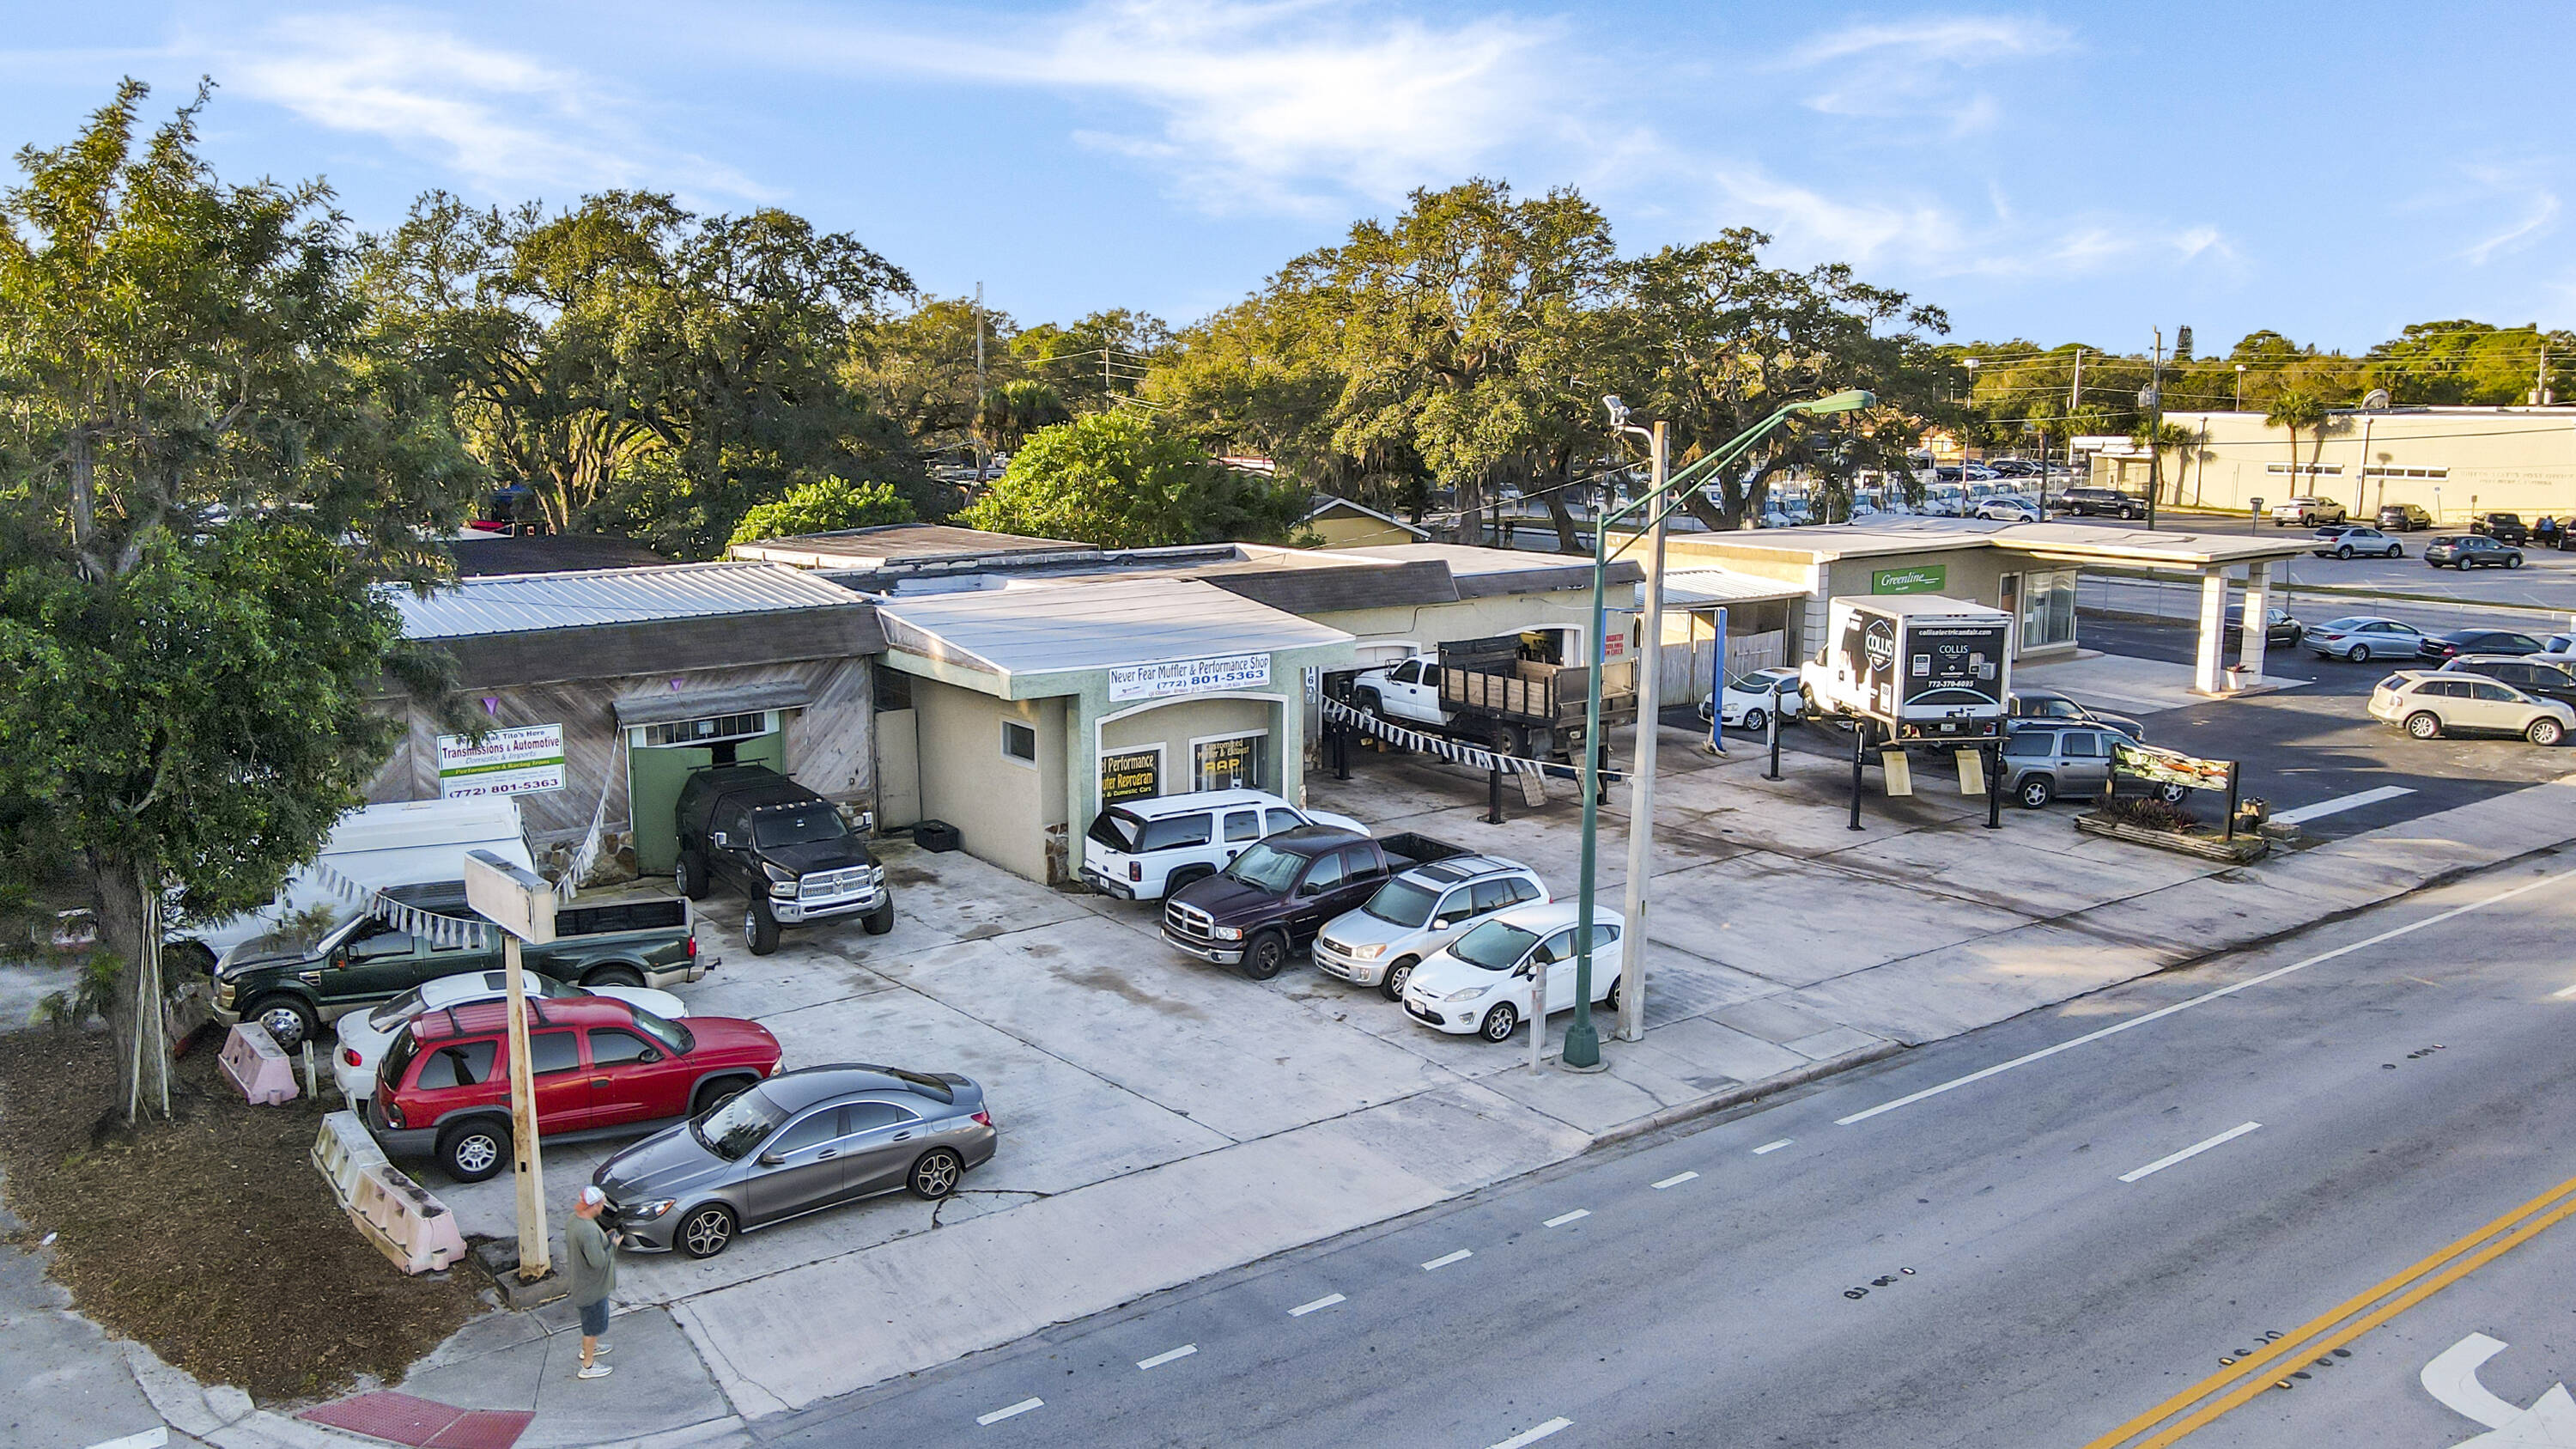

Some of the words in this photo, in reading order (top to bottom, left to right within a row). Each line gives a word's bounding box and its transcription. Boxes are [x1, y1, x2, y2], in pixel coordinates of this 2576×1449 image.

[1881, 572, 1924, 586] Greenline
[1867, 635, 1893, 656] COLLIS
[1939, 645, 1968, 654] COLLIS
[1111, 670, 1135, 684] Never
[1138, 667, 1156, 680] Fear
[1159, 663, 1188, 679] Muffler
[1189, 667, 1196, 675] &
[1199, 658, 1248, 675] Performance
[1250, 655, 1268, 670] Shop
[1157, 679, 1187, 690] (772)
[1191, 670, 1264, 685] 801-5363
[503, 731, 525, 740] Tito's
[442, 742, 503, 759] Transmissions
[513, 735, 560, 751] Automotive
[1220, 748, 1226, 757] &
[465, 755, 499, 764] Domestic
[508, 750, 537, 759] Imports
[1108, 754, 1154, 773] Performance
[455, 765, 501, 775] Performance
[1117, 772, 1153, 789] Reprogram
[449, 788, 486, 799] (772)
[491, 778, 558, 794] 801-5363
[1113, 788, 1138, 797] Domestic
